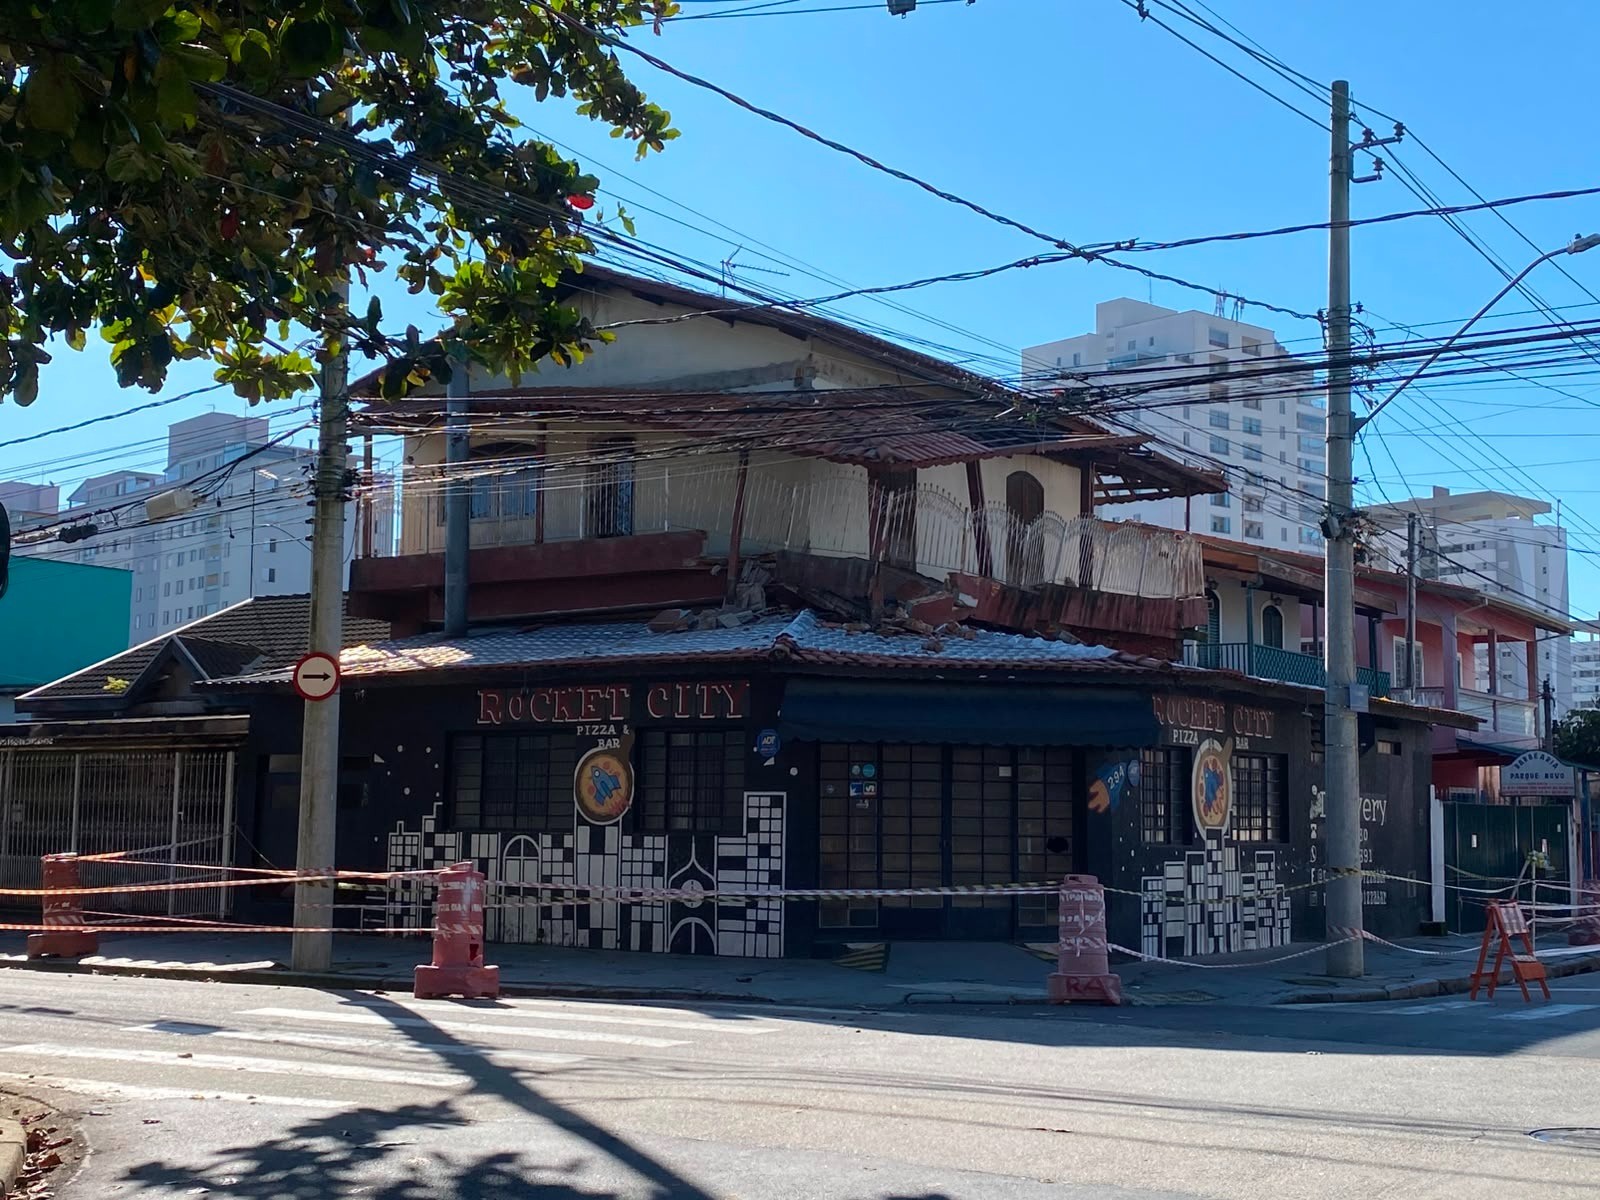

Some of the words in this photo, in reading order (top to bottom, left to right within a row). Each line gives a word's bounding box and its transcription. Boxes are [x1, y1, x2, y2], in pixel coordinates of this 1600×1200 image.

[477, 687, 630, 724] ROCKET
[647, 683, 750, 719] CITY
[1233, 703, 1274, 738] CITY
[577, 725, 616, 736] PIZZA
[622, 725, 630, 735] &
[598, 738, 620, 748] BAR
[762, 736, 776, 745] ADT
[1173, 729, 1199, 744] PIZZA
[1235, 737, 1249, 749] BAR
[1513, 752, 1559, 769] BARBEARIA
[1510, 772, 1540, 781] PARQUE
